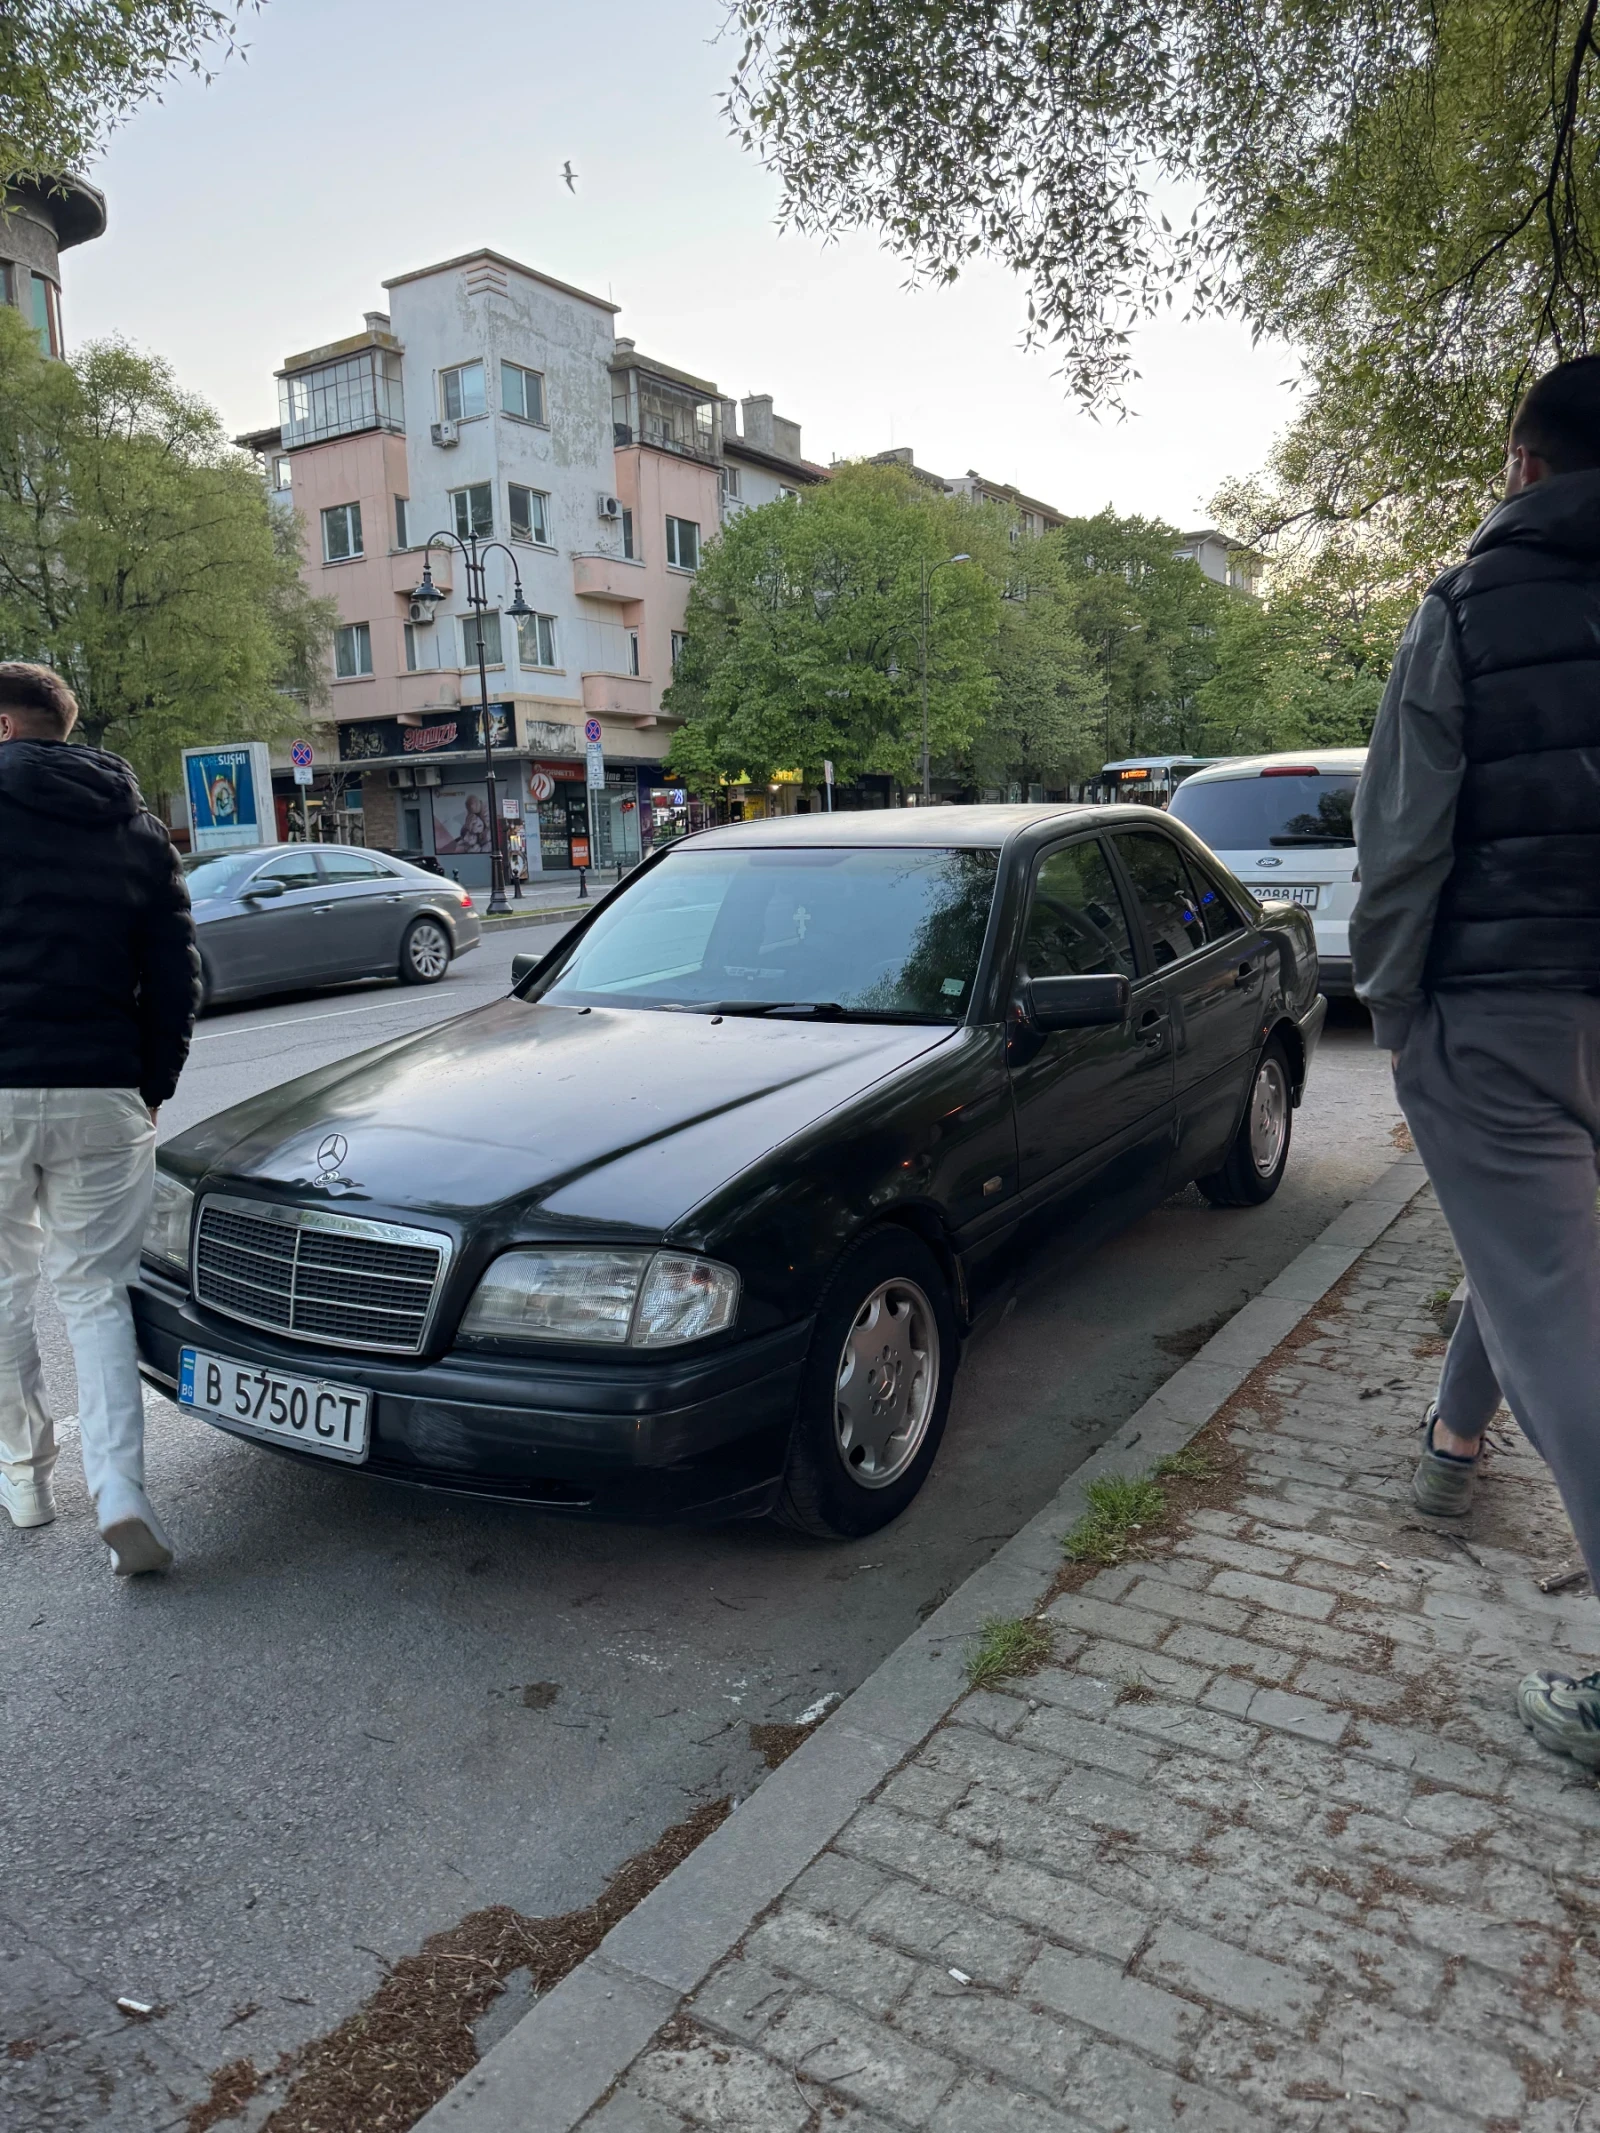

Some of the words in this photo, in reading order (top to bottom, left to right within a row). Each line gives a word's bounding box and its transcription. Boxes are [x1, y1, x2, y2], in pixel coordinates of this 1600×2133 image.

[218, 752, 246, 766] SUSHI
[1293, 888, 1315, 904] HT
[181, 1383, 194, 1398] BG
[206, 1362, 222, 1406] B
[235, 1370, 308, 1430] 5750
[315, 1391, 361, 1443] CT
